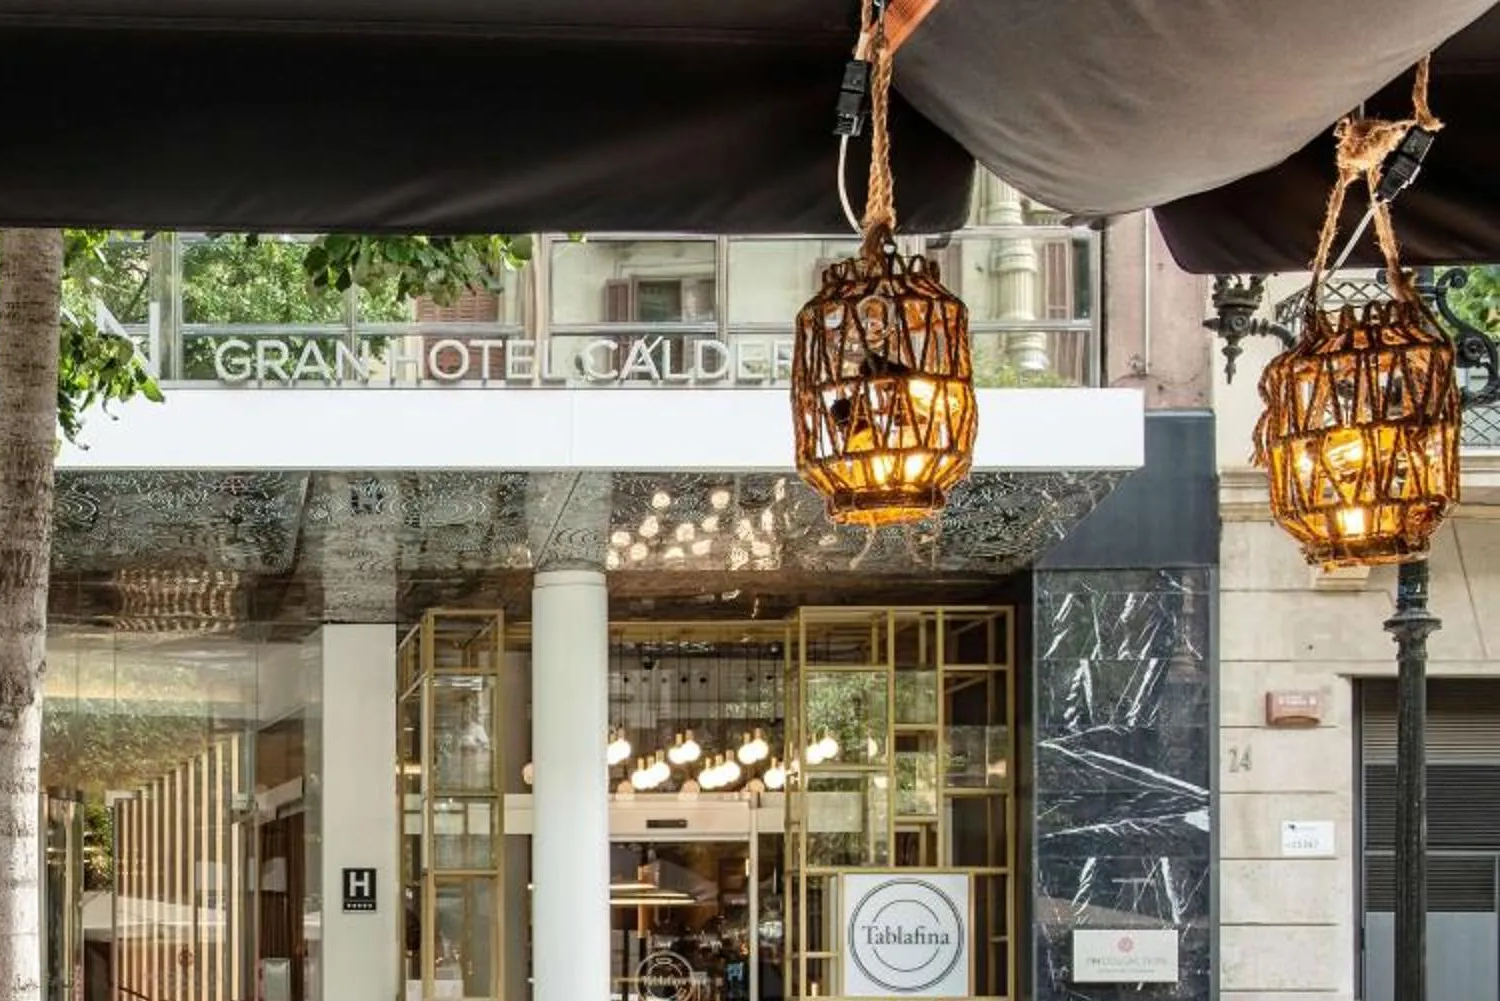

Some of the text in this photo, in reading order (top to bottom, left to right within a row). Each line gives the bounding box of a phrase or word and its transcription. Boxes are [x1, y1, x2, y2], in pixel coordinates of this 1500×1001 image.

[215, 338, 795, 380] GRAN HOTEL CALDER
[1228, 745, 1252, 772] 24
[350, 871, 369, 897] H
[862, 925, 950, 945] Tablafina
